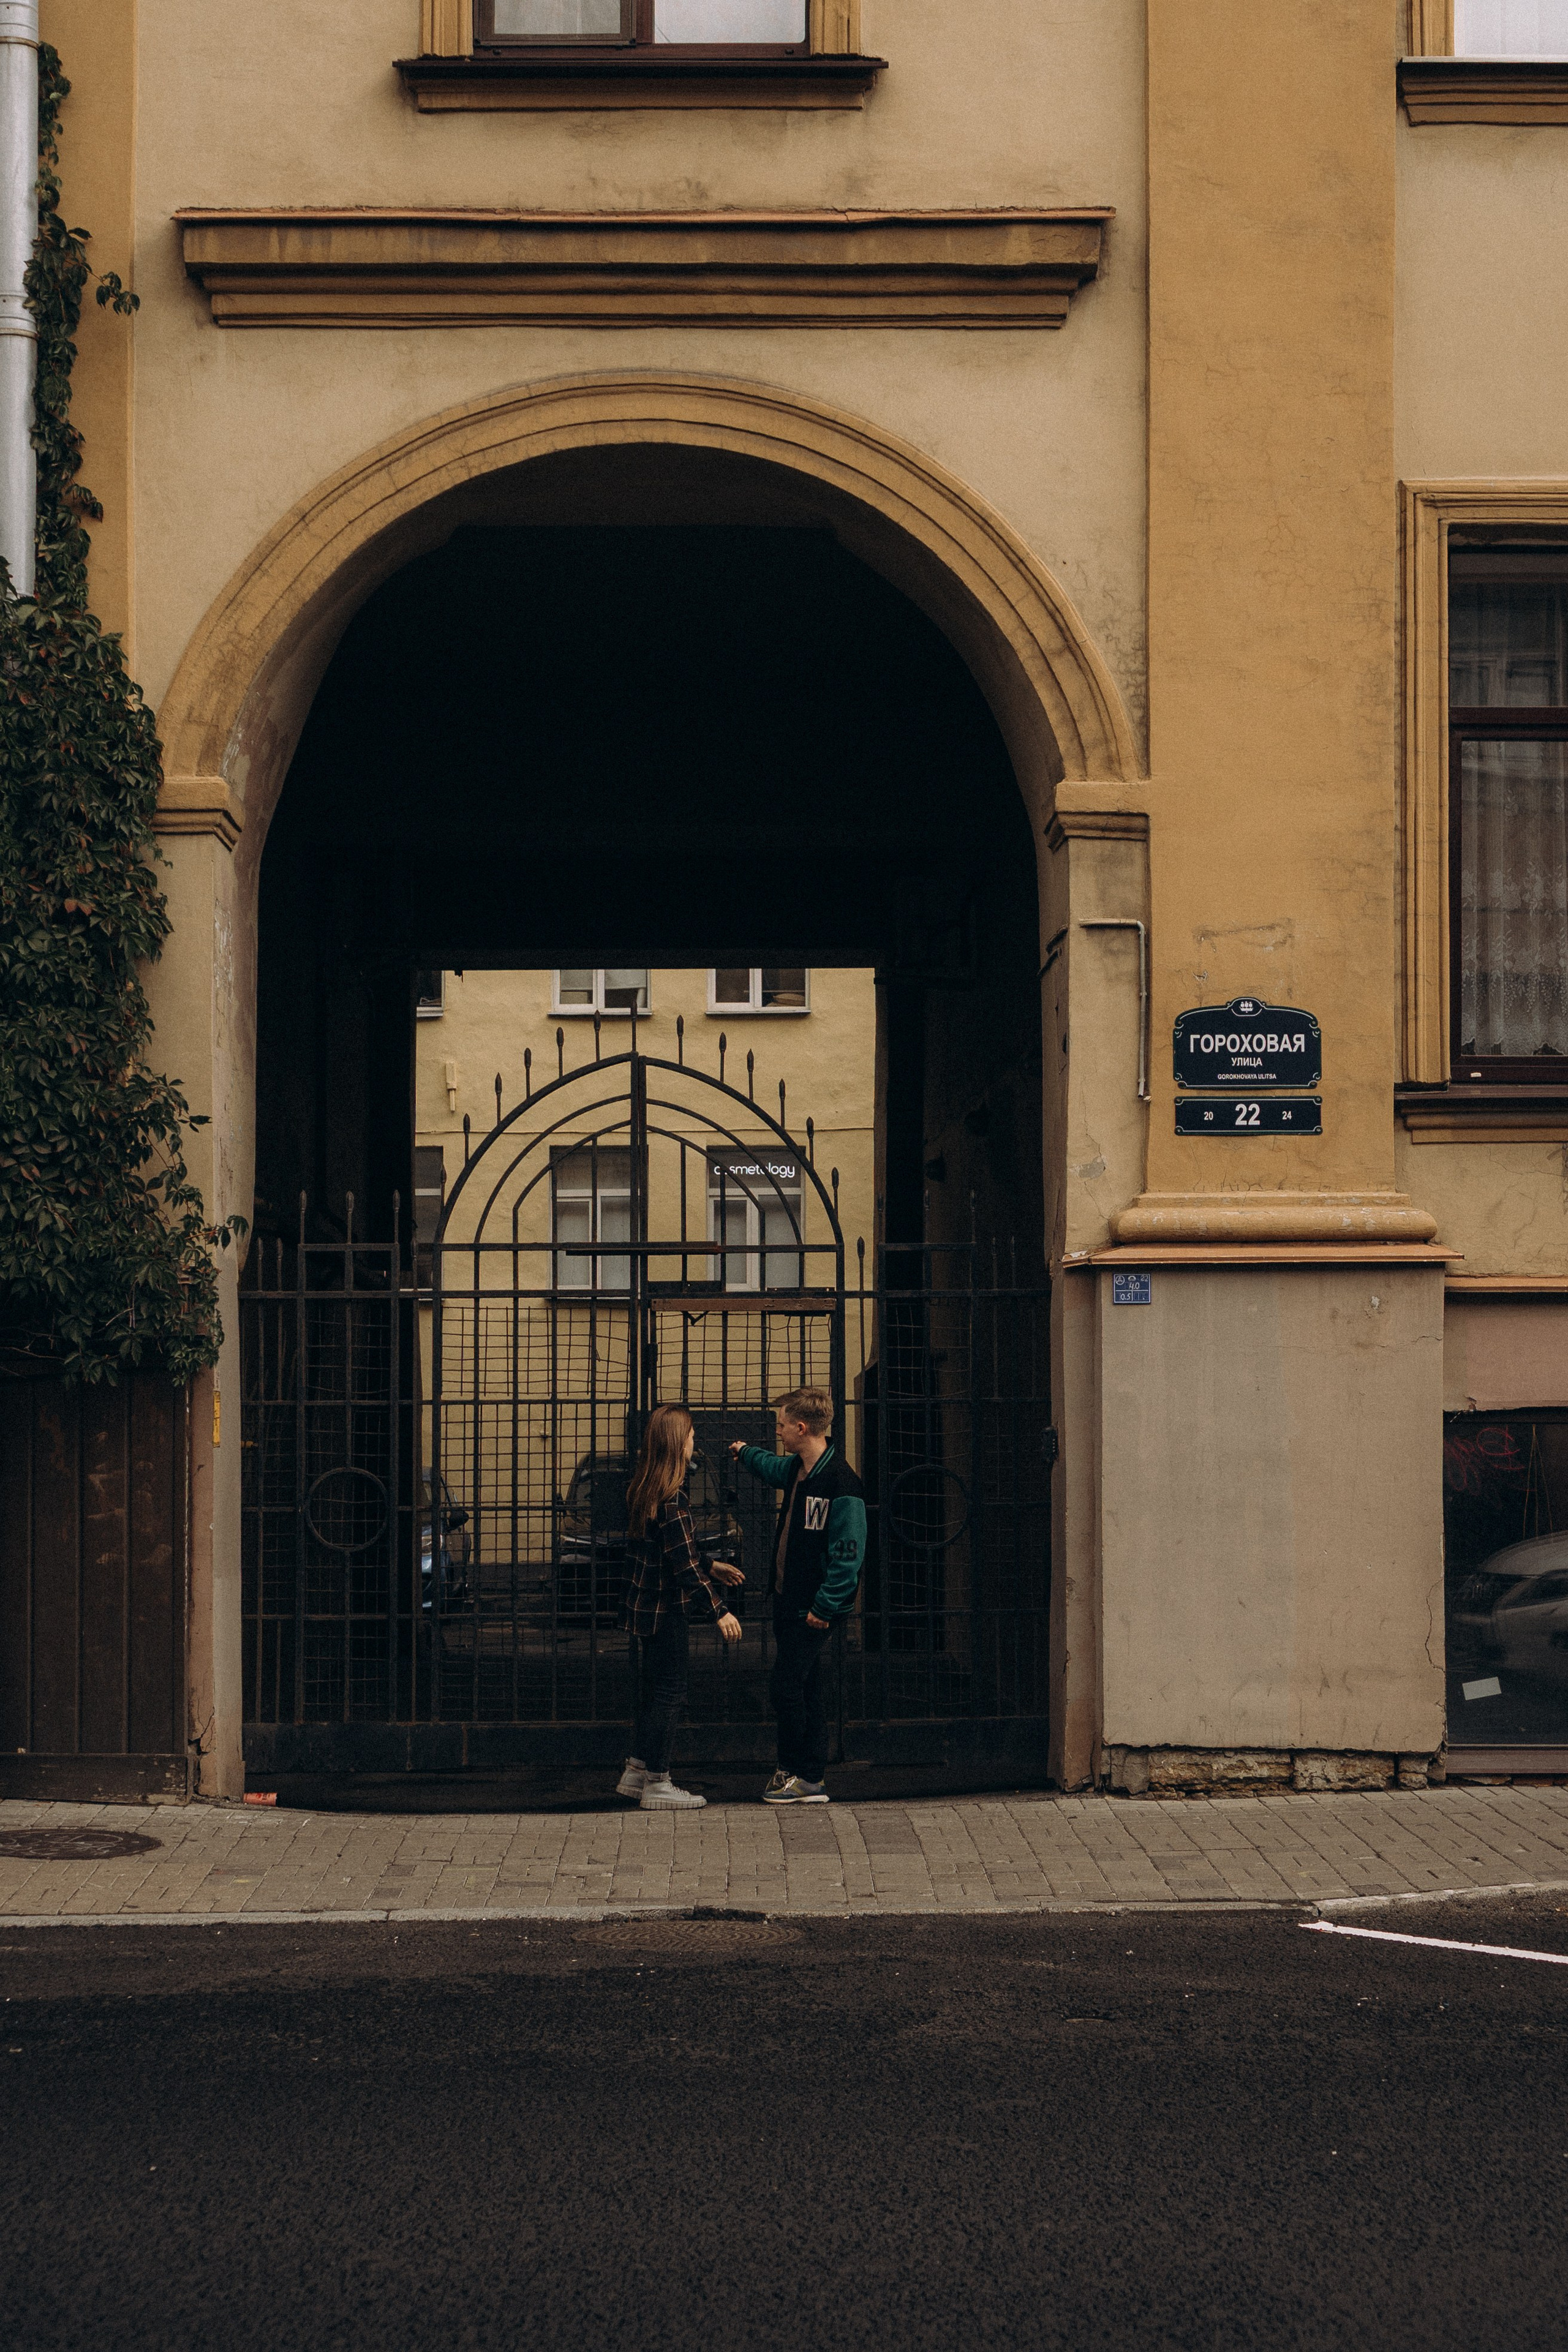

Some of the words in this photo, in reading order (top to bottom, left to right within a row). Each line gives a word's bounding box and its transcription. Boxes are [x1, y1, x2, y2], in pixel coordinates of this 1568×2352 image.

[1189, 1034, 1305, 1053] ГОРОХОВАЯ
[1231, 1057, 1262, 1068] УЛИЦА
[1204, 1112, 1213, 1120] 20
[1235, 1104, 1261, 1125] 22
[1282, 1111, 1292, 1120] 24
[714, 1162, 795, 1178] csmetlogy
[804, 1496, 829, 1530] W
[832, 1539, 858, 1560] 49
